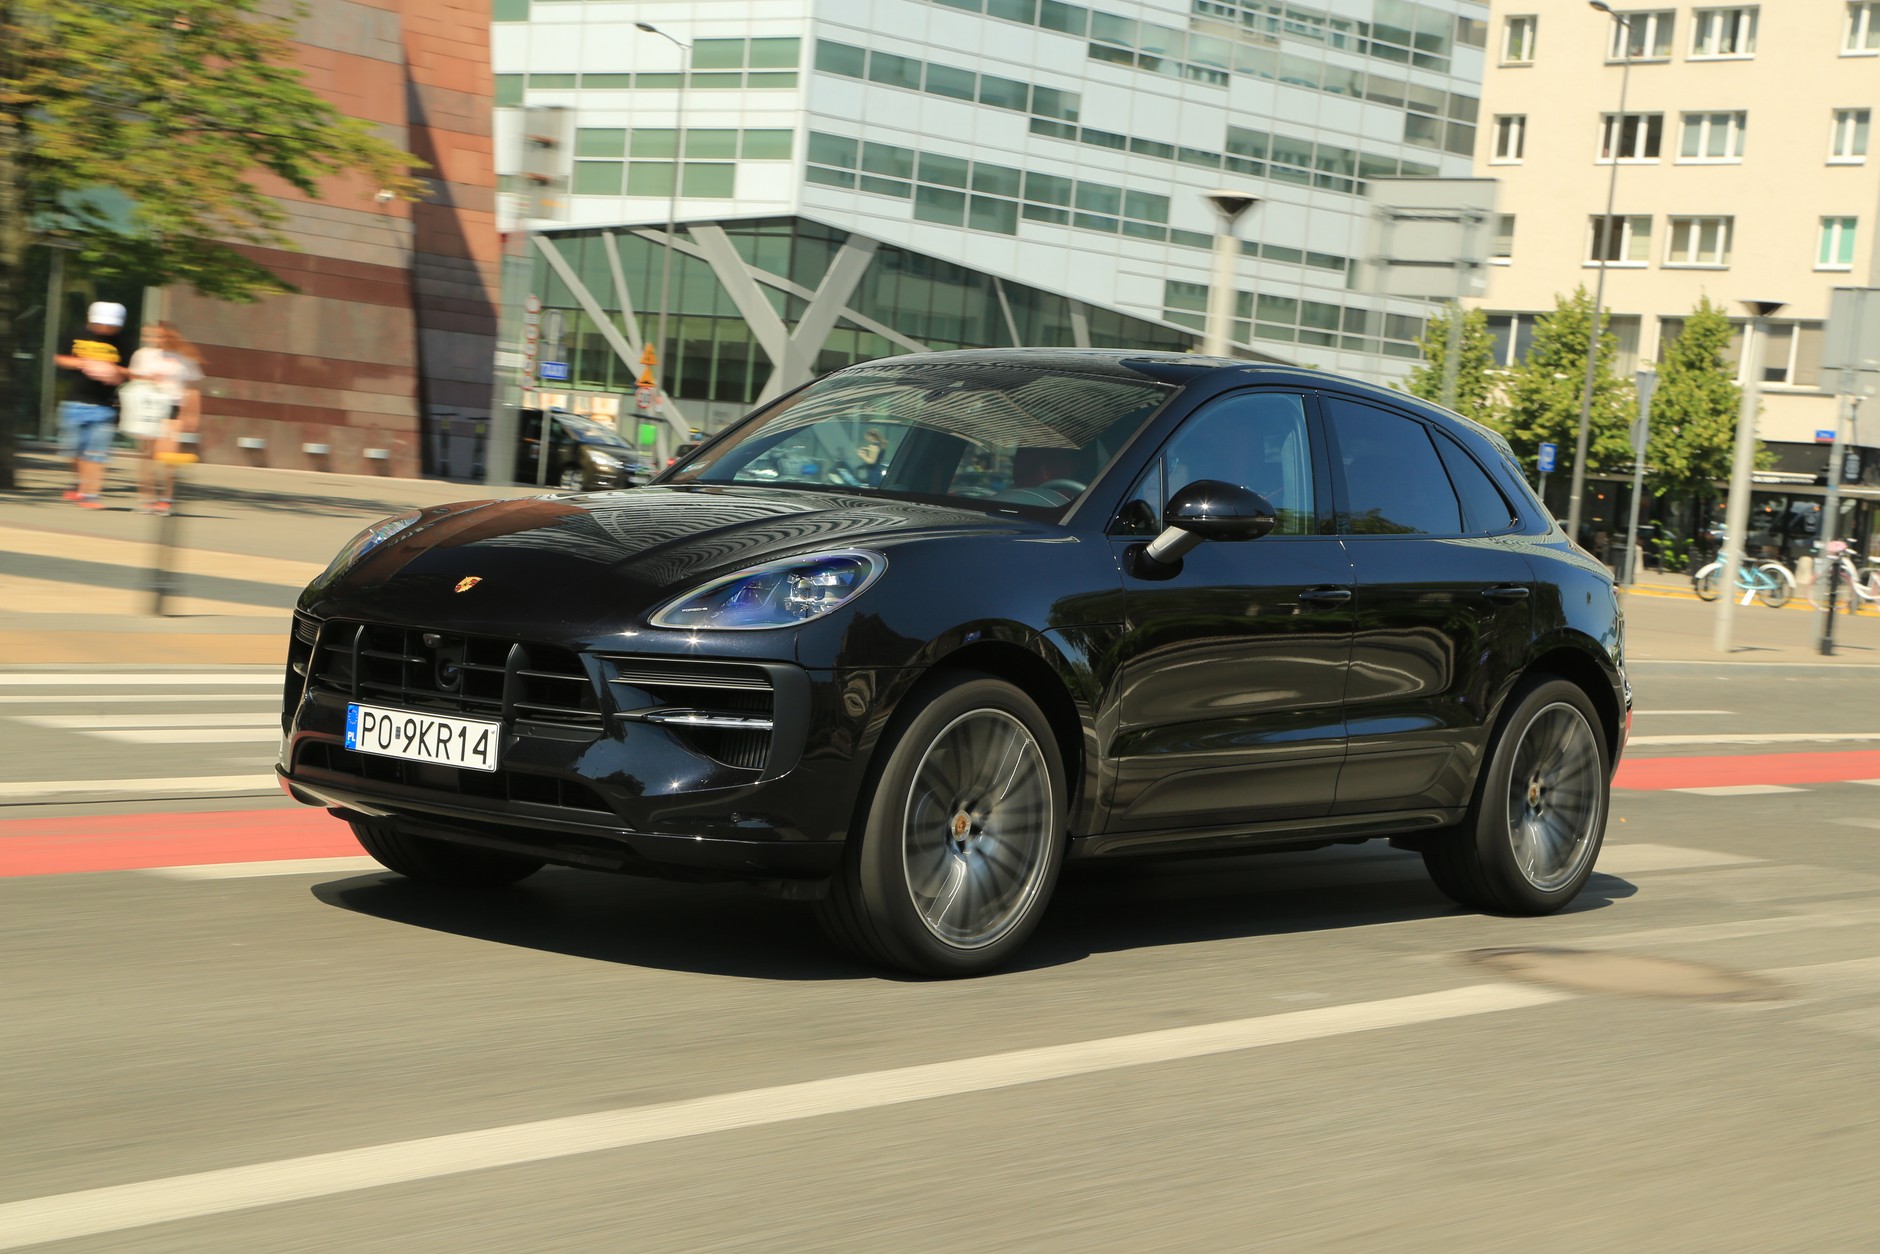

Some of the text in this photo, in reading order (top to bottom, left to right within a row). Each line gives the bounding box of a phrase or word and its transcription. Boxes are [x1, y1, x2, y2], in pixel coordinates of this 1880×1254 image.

[347, 731, 356, 742] PL
[361, 711, 489, 765] PO 9KR14
